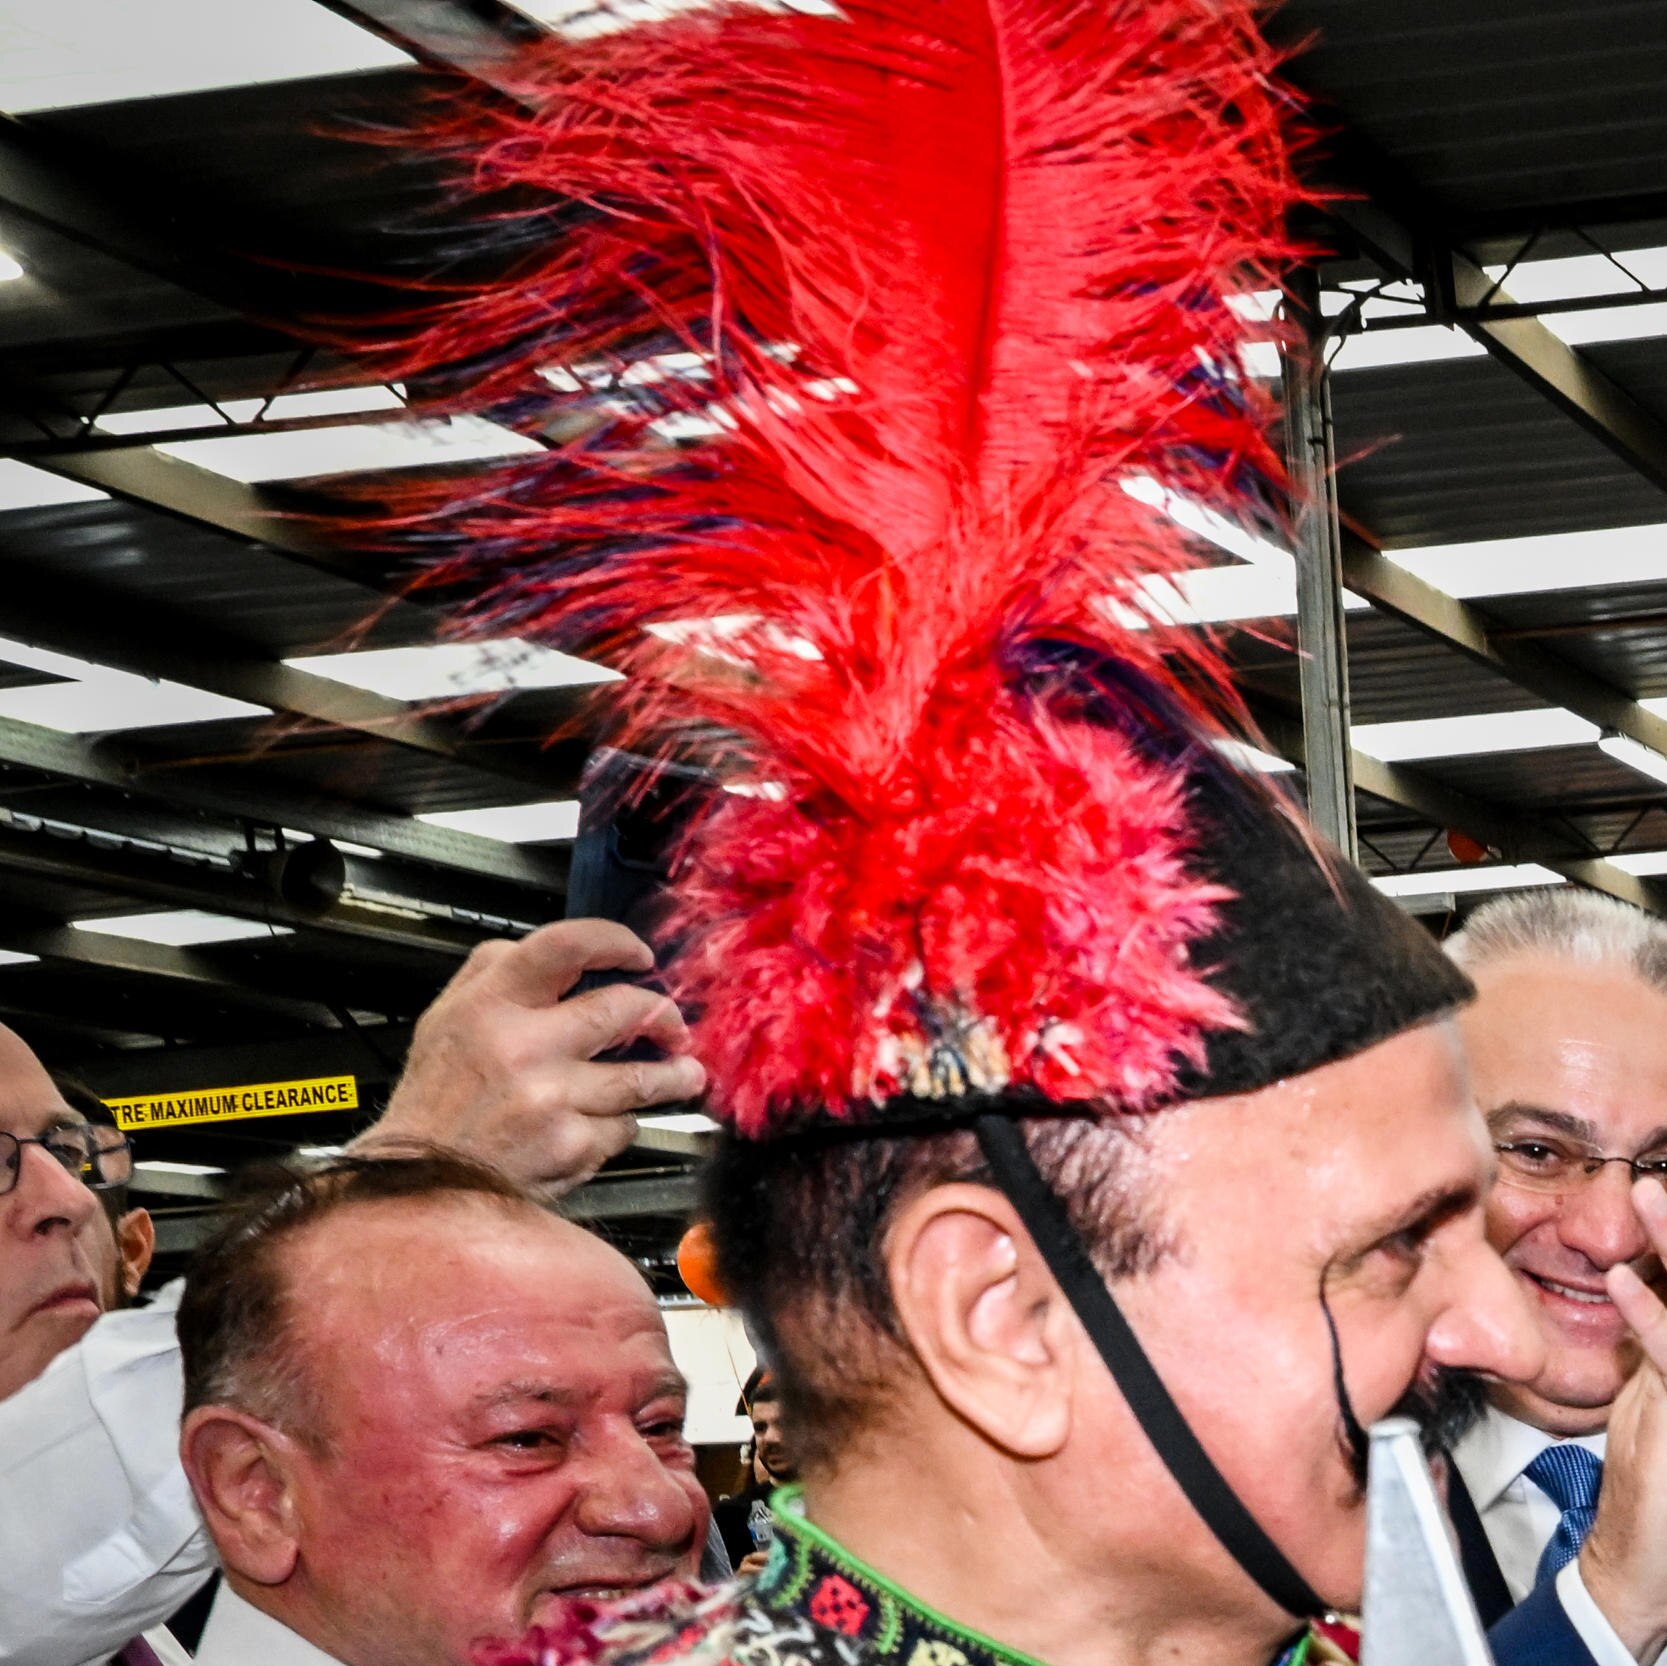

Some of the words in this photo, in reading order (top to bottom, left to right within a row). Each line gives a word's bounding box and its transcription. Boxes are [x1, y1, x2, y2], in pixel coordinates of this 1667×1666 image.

[110, 1103, 146, 1124] TRE
[150, 1094, 236, 1121] MAXIMUM
[242, 1083, 349, 1112] CLEARANCE
